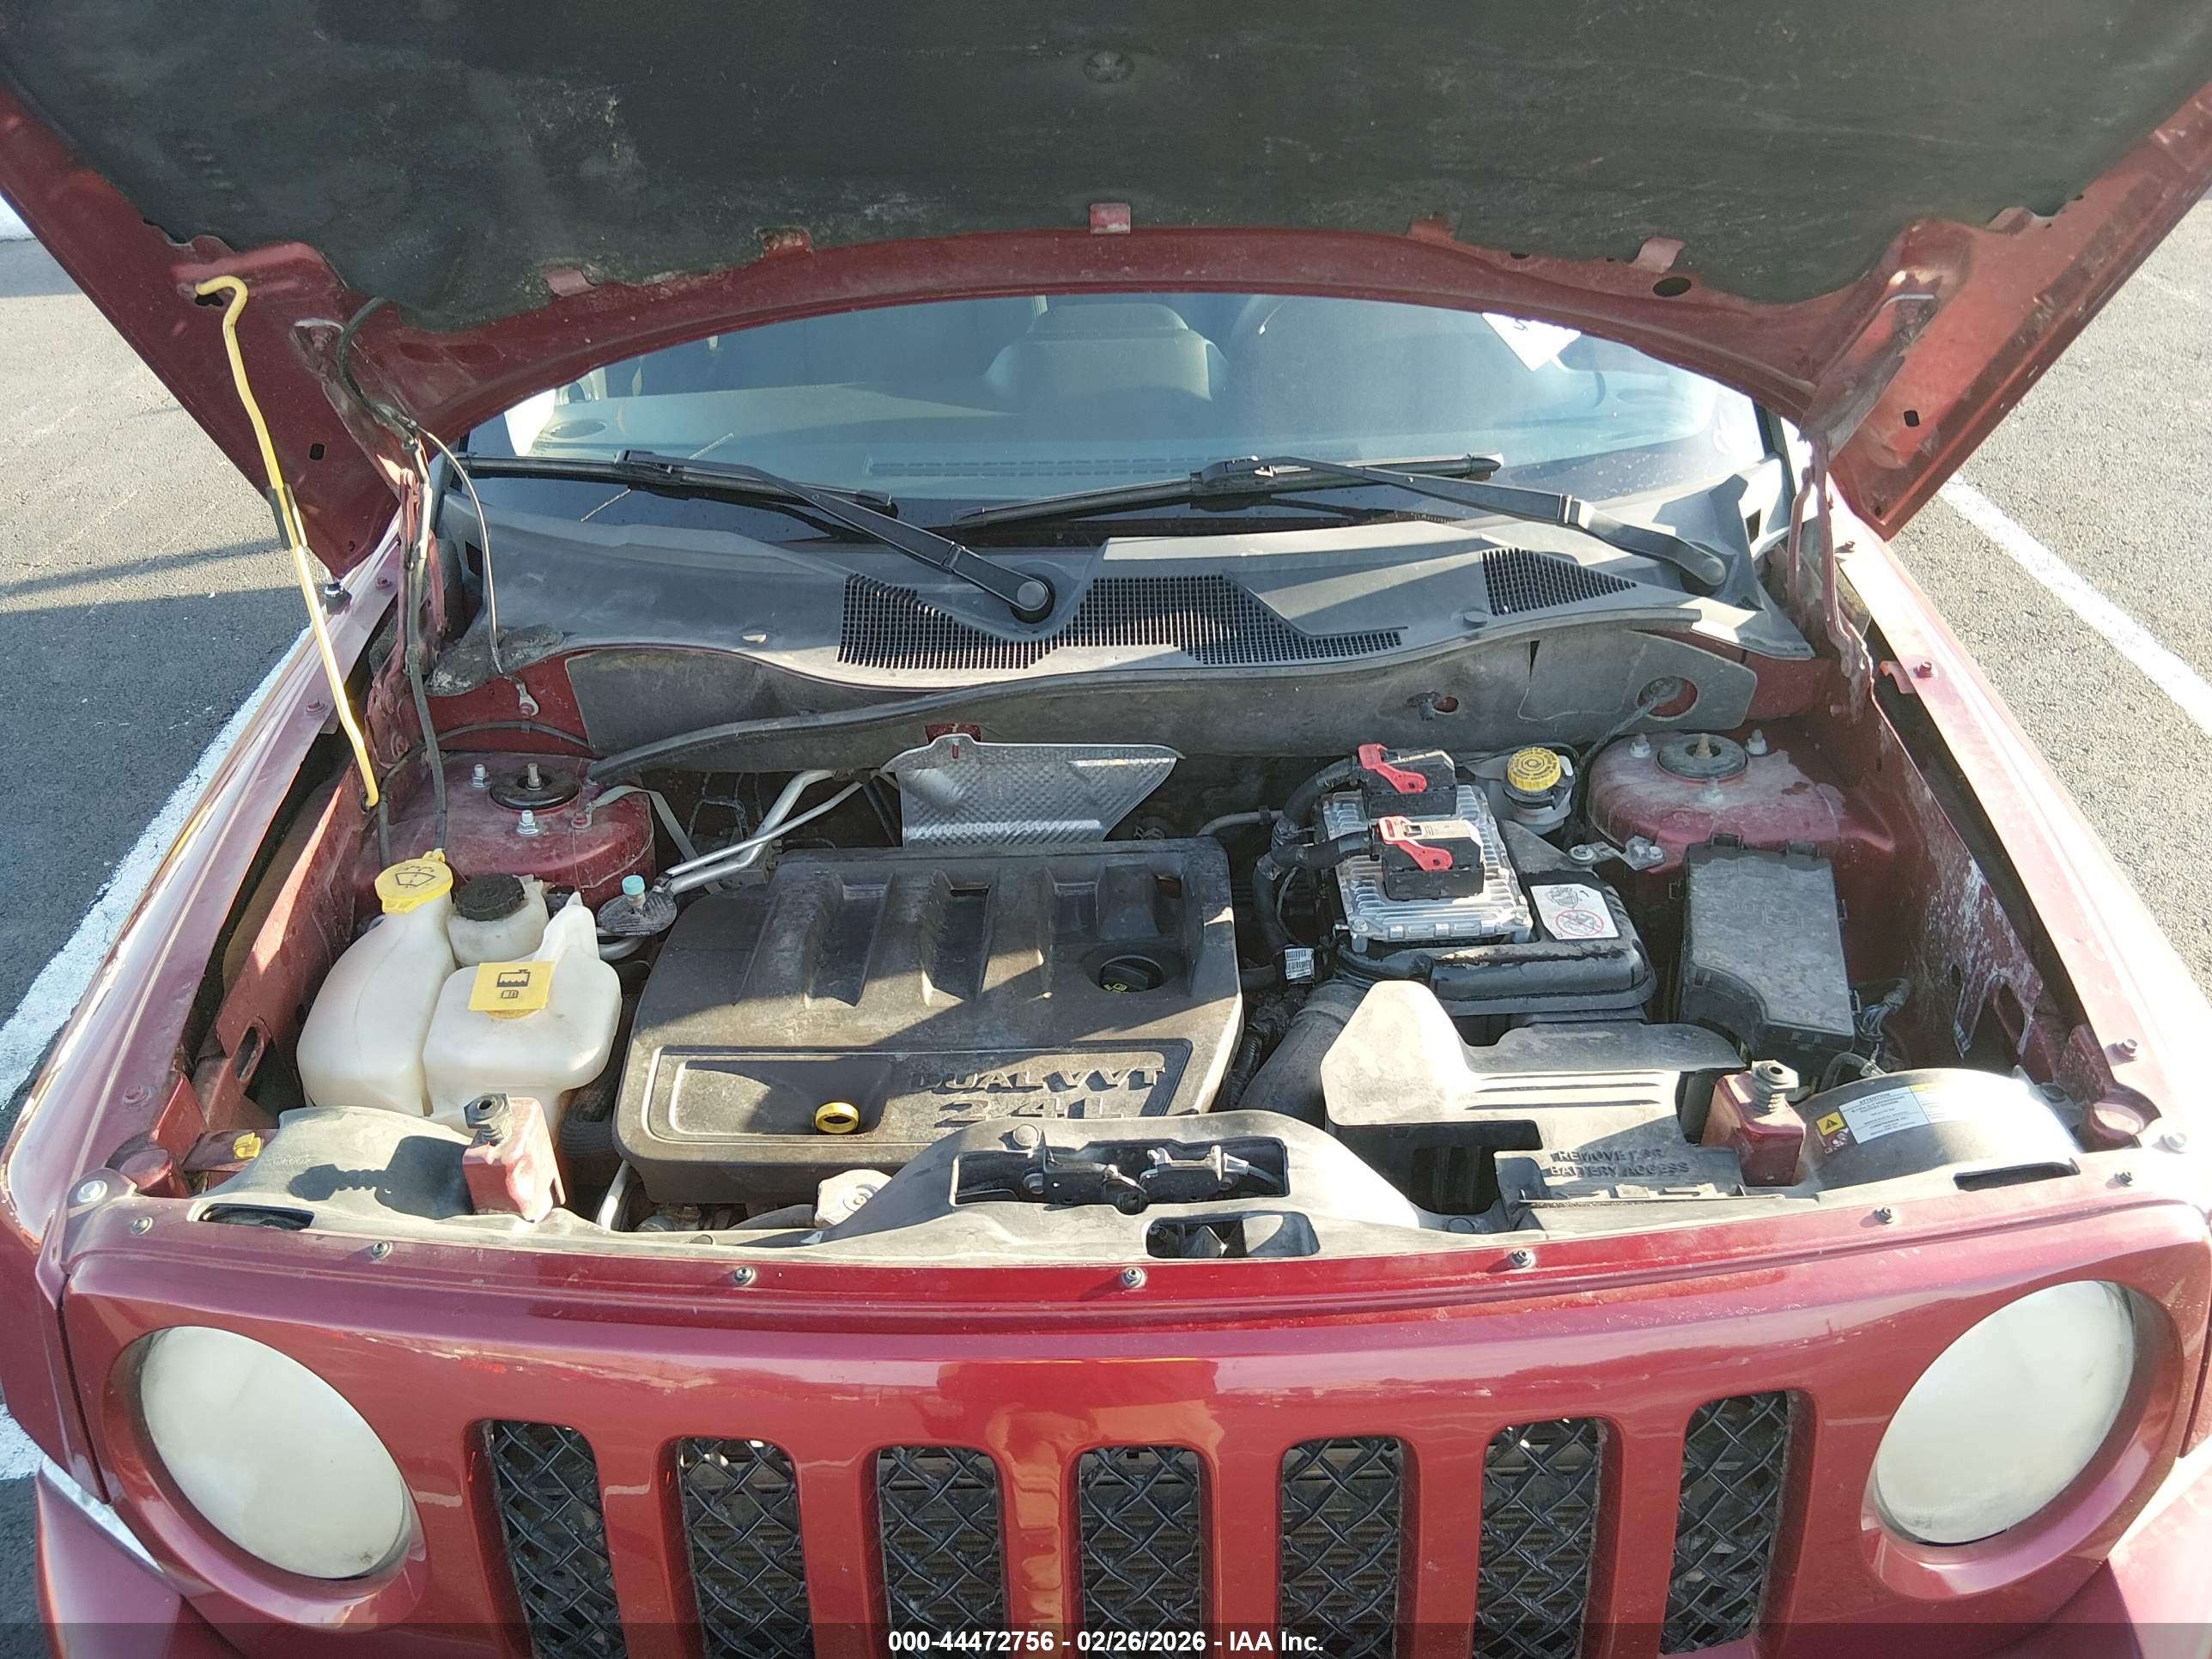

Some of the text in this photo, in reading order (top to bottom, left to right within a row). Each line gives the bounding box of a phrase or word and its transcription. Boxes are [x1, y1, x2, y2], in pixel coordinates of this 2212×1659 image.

[910, 1066, 1166, 1090] DUAL VVT
[1557, 1147, 1664, 1162] REMOVE FOR
[1549, 1162, 1690, 1176] BATTERY ACCESS
